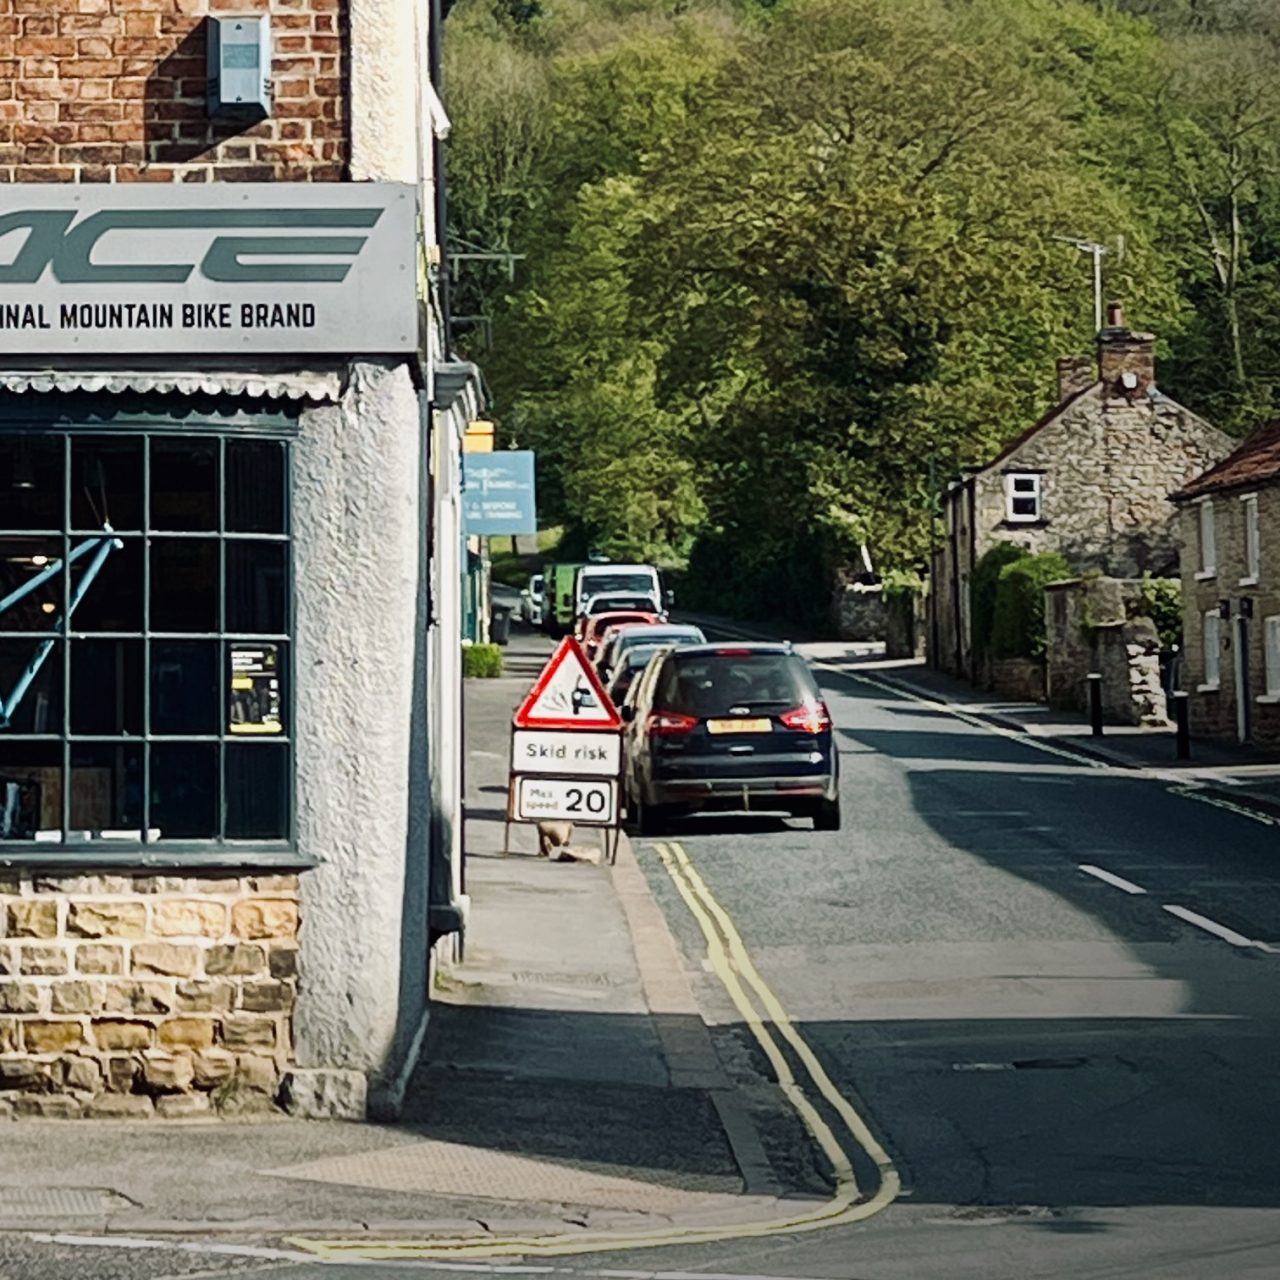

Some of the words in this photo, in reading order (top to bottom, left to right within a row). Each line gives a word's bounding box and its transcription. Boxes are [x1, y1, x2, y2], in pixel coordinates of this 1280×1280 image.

[60, 303, 173, 329] MOUNTAIN
[182, 303, 232, 328] BIKE
[240, 303, 315, 328] BRAND
[526, 743, 566, 759] Skid
[574, 744, 608, 760] risk
[565, 788, 606, 813] 20
